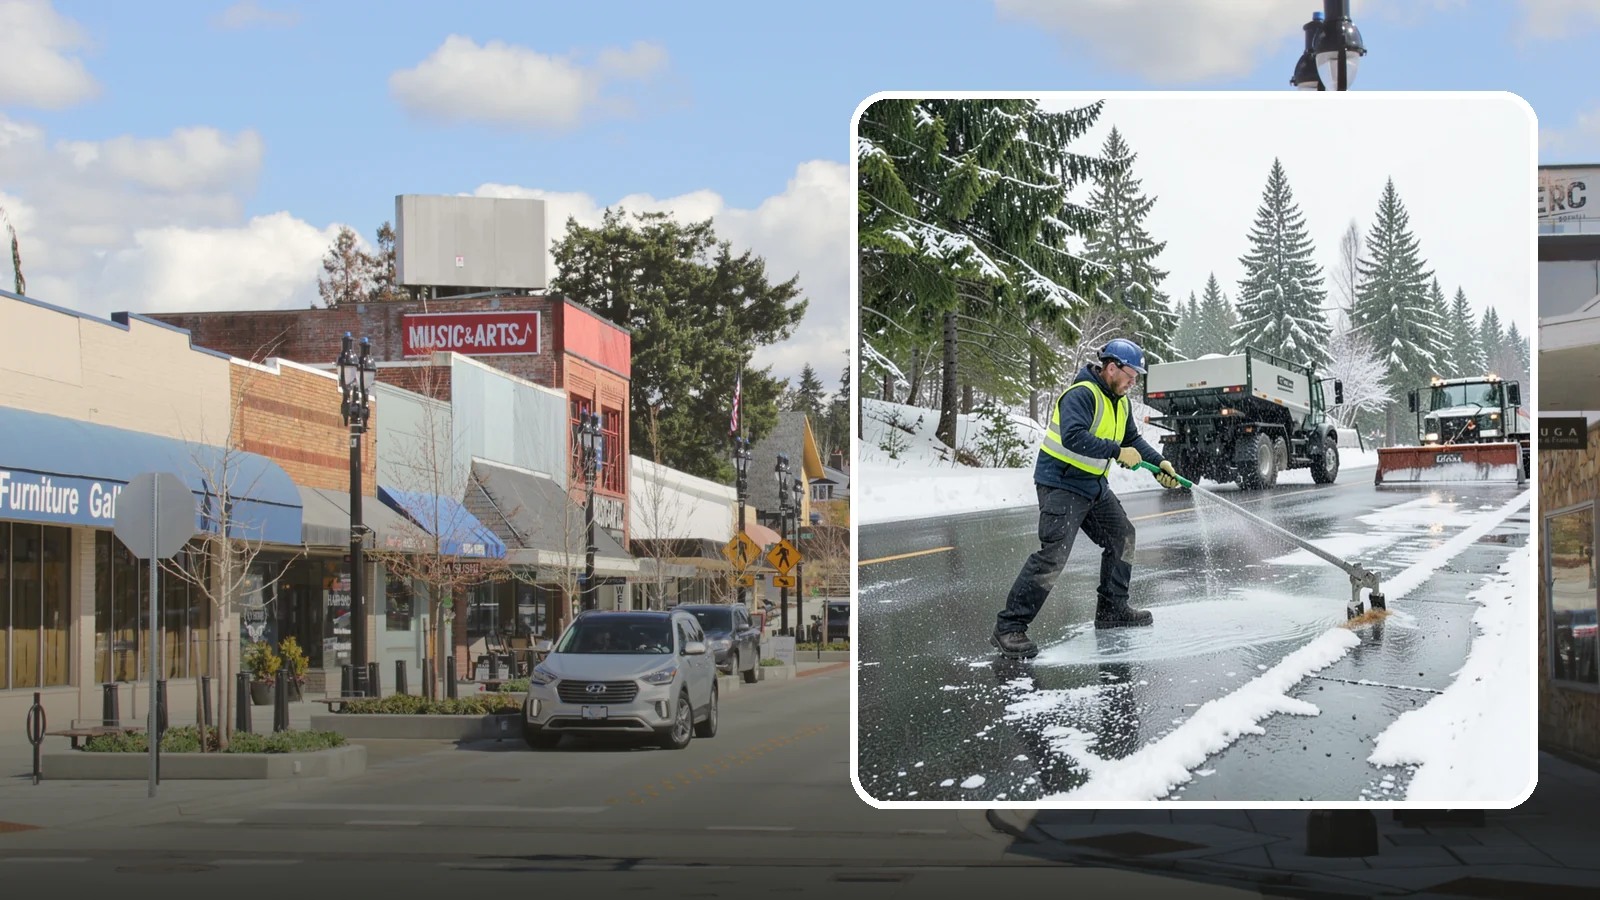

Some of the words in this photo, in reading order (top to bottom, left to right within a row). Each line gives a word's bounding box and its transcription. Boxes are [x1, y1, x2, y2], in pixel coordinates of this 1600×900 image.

[409, 323, 520, 348] MUSIC&ARTS
[0, 471, 79, 515] Furniture
[89, 482, 122, 519] Gal
